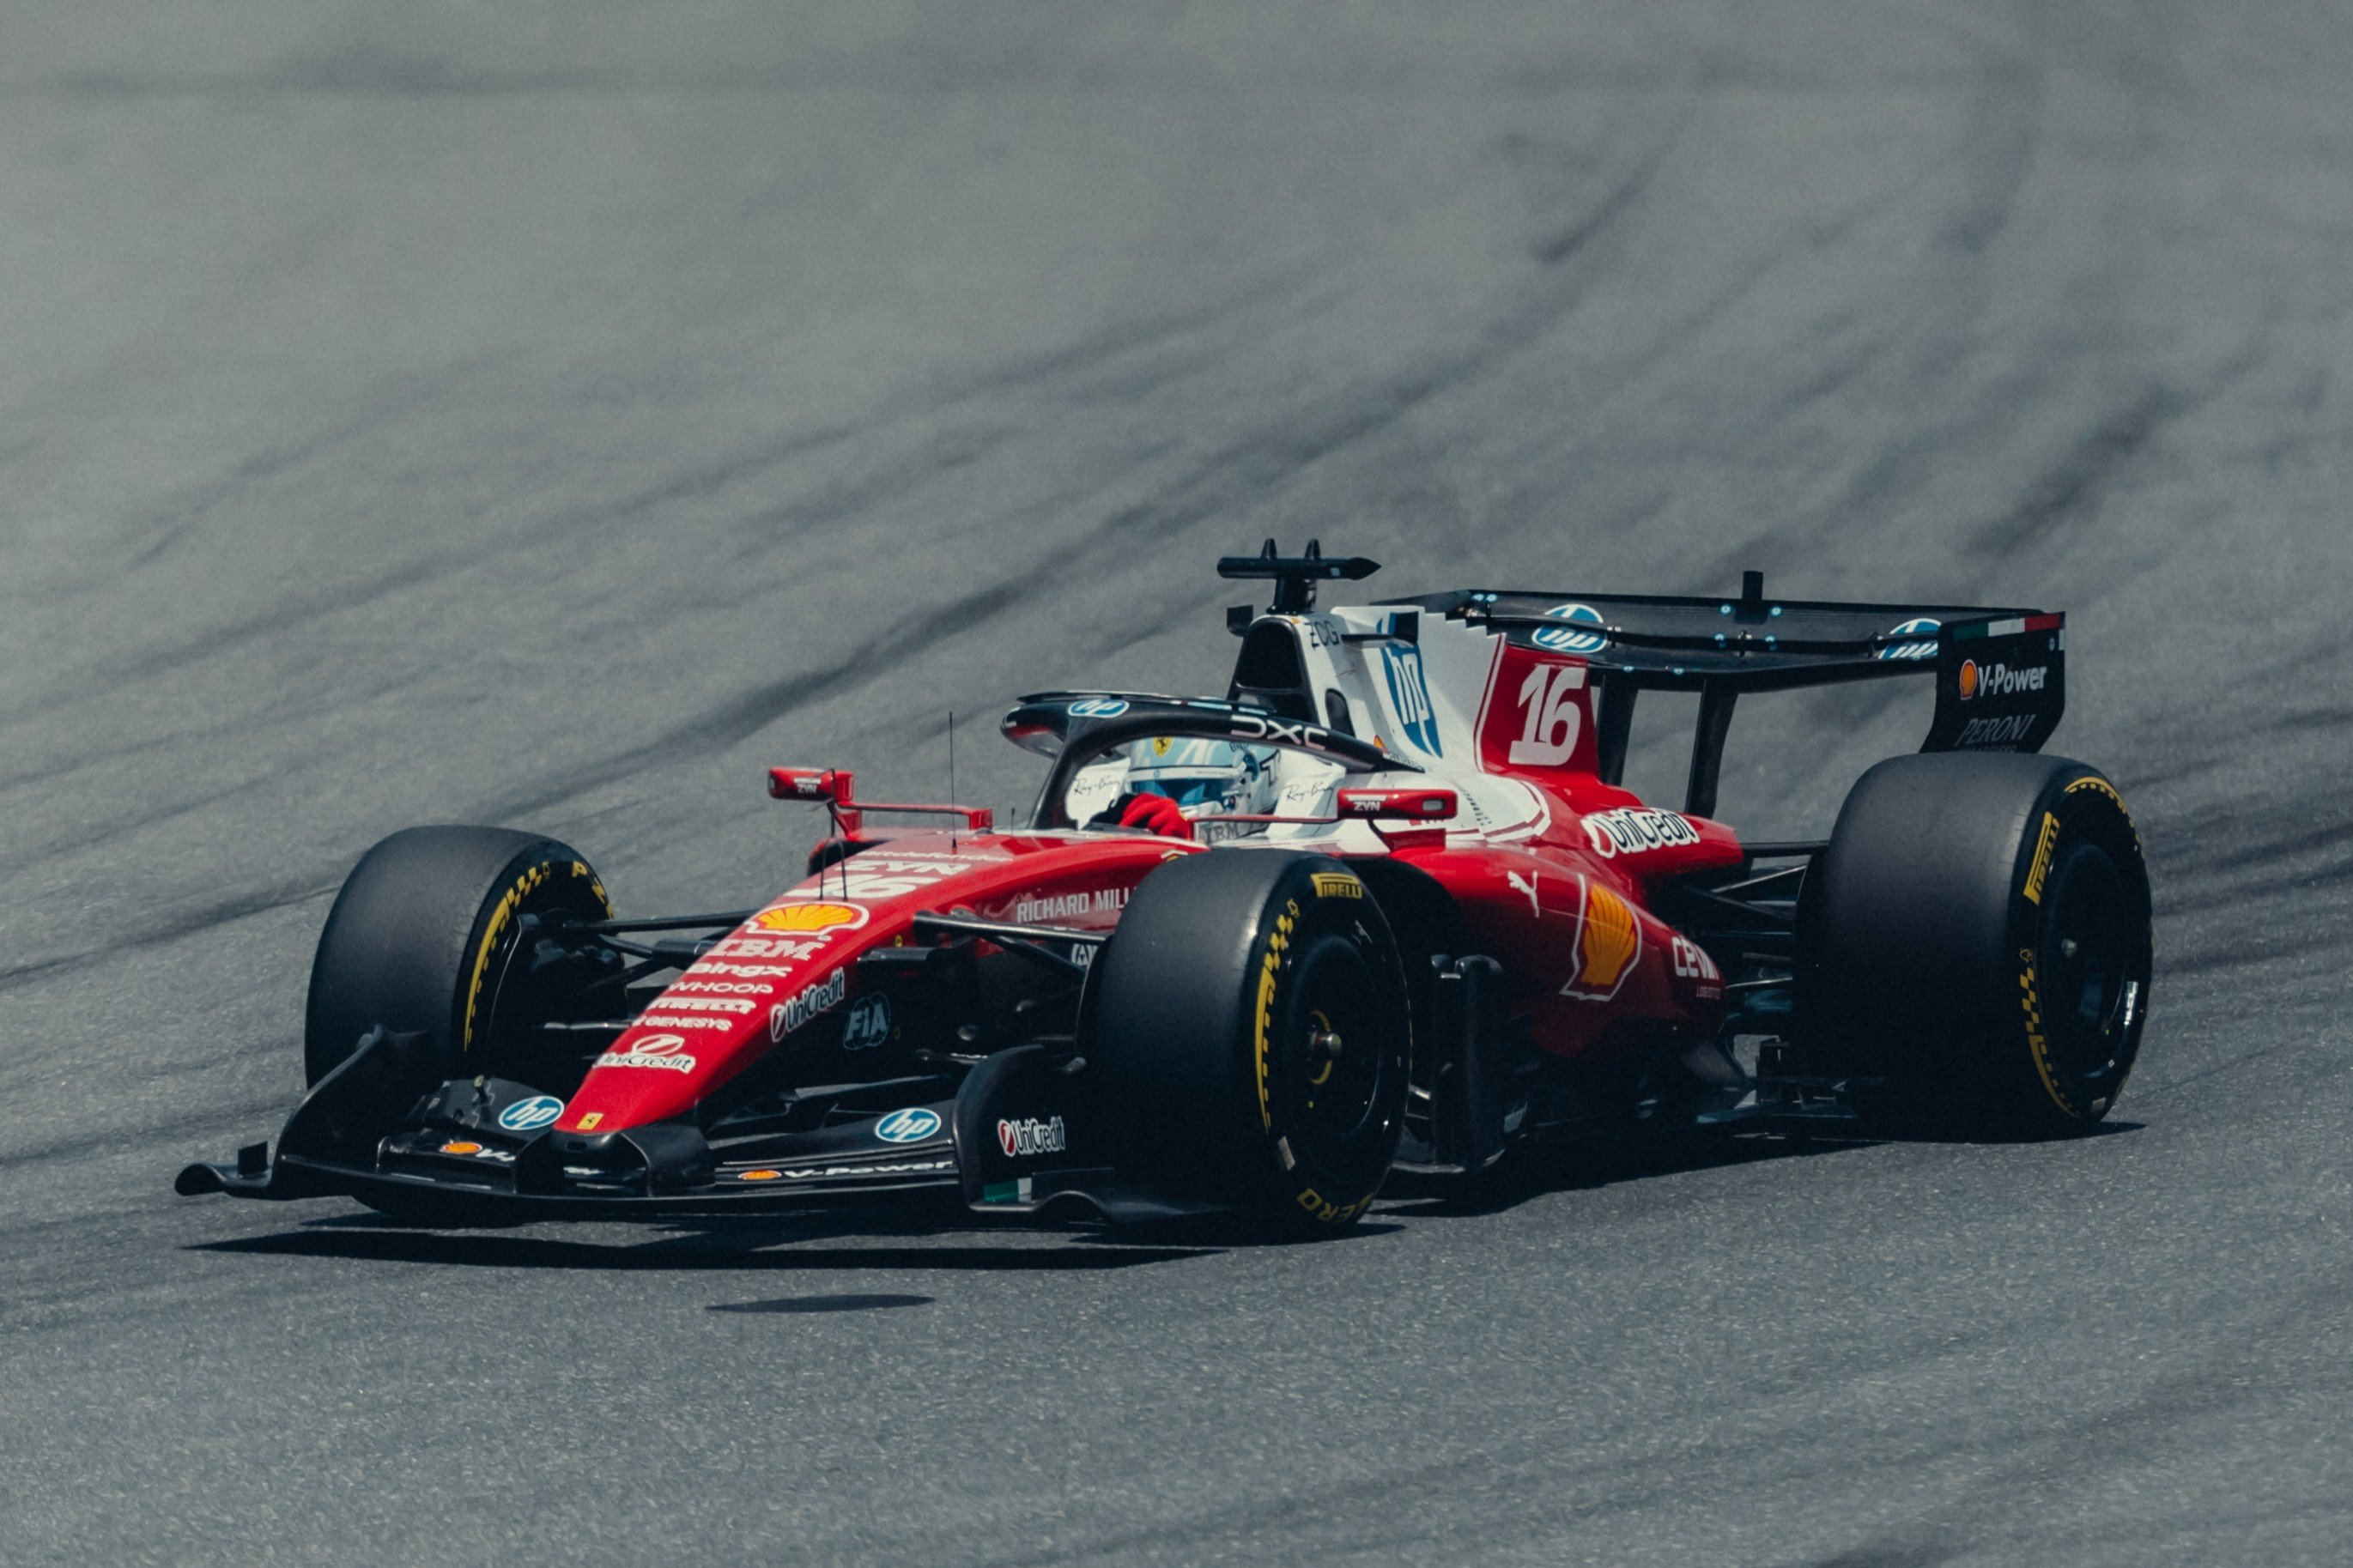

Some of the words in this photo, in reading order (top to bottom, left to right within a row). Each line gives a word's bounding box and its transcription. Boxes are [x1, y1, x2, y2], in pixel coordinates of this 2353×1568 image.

[1979, 663, 2047, 696] V-Power
[1508, 664, 1586, 766] 16
[1954, 714, 2036, 747] PERONI
[1230, 715, 1327, 752] DXC
[1352, 797, 1383, 812] ZYN
[1593, 808, 1698, 850] UniCredit
[2023, 811, 2060, 905] PIRELLI
[783, 875, 943, 899] 16
[1310, 873, 1362, 899] PIRELLI
[1017, 893, 1089, 923] RICHARD
[706, 940, 825, 960] IBM
[669, 981, 773, 994] WHOOP
[787, 969, 845, 1032] UniCredit
[645, 1015, 732, 1032] GENESYS
[845, 1002, 888, 1042] FIA
[501, 1096, 561, 1129] hp
[878, 1109, 939, 1141] hp
[1011, 1117, 1065, 1154] UniCredit
[784, 1161, 953, 1178] V-Power
